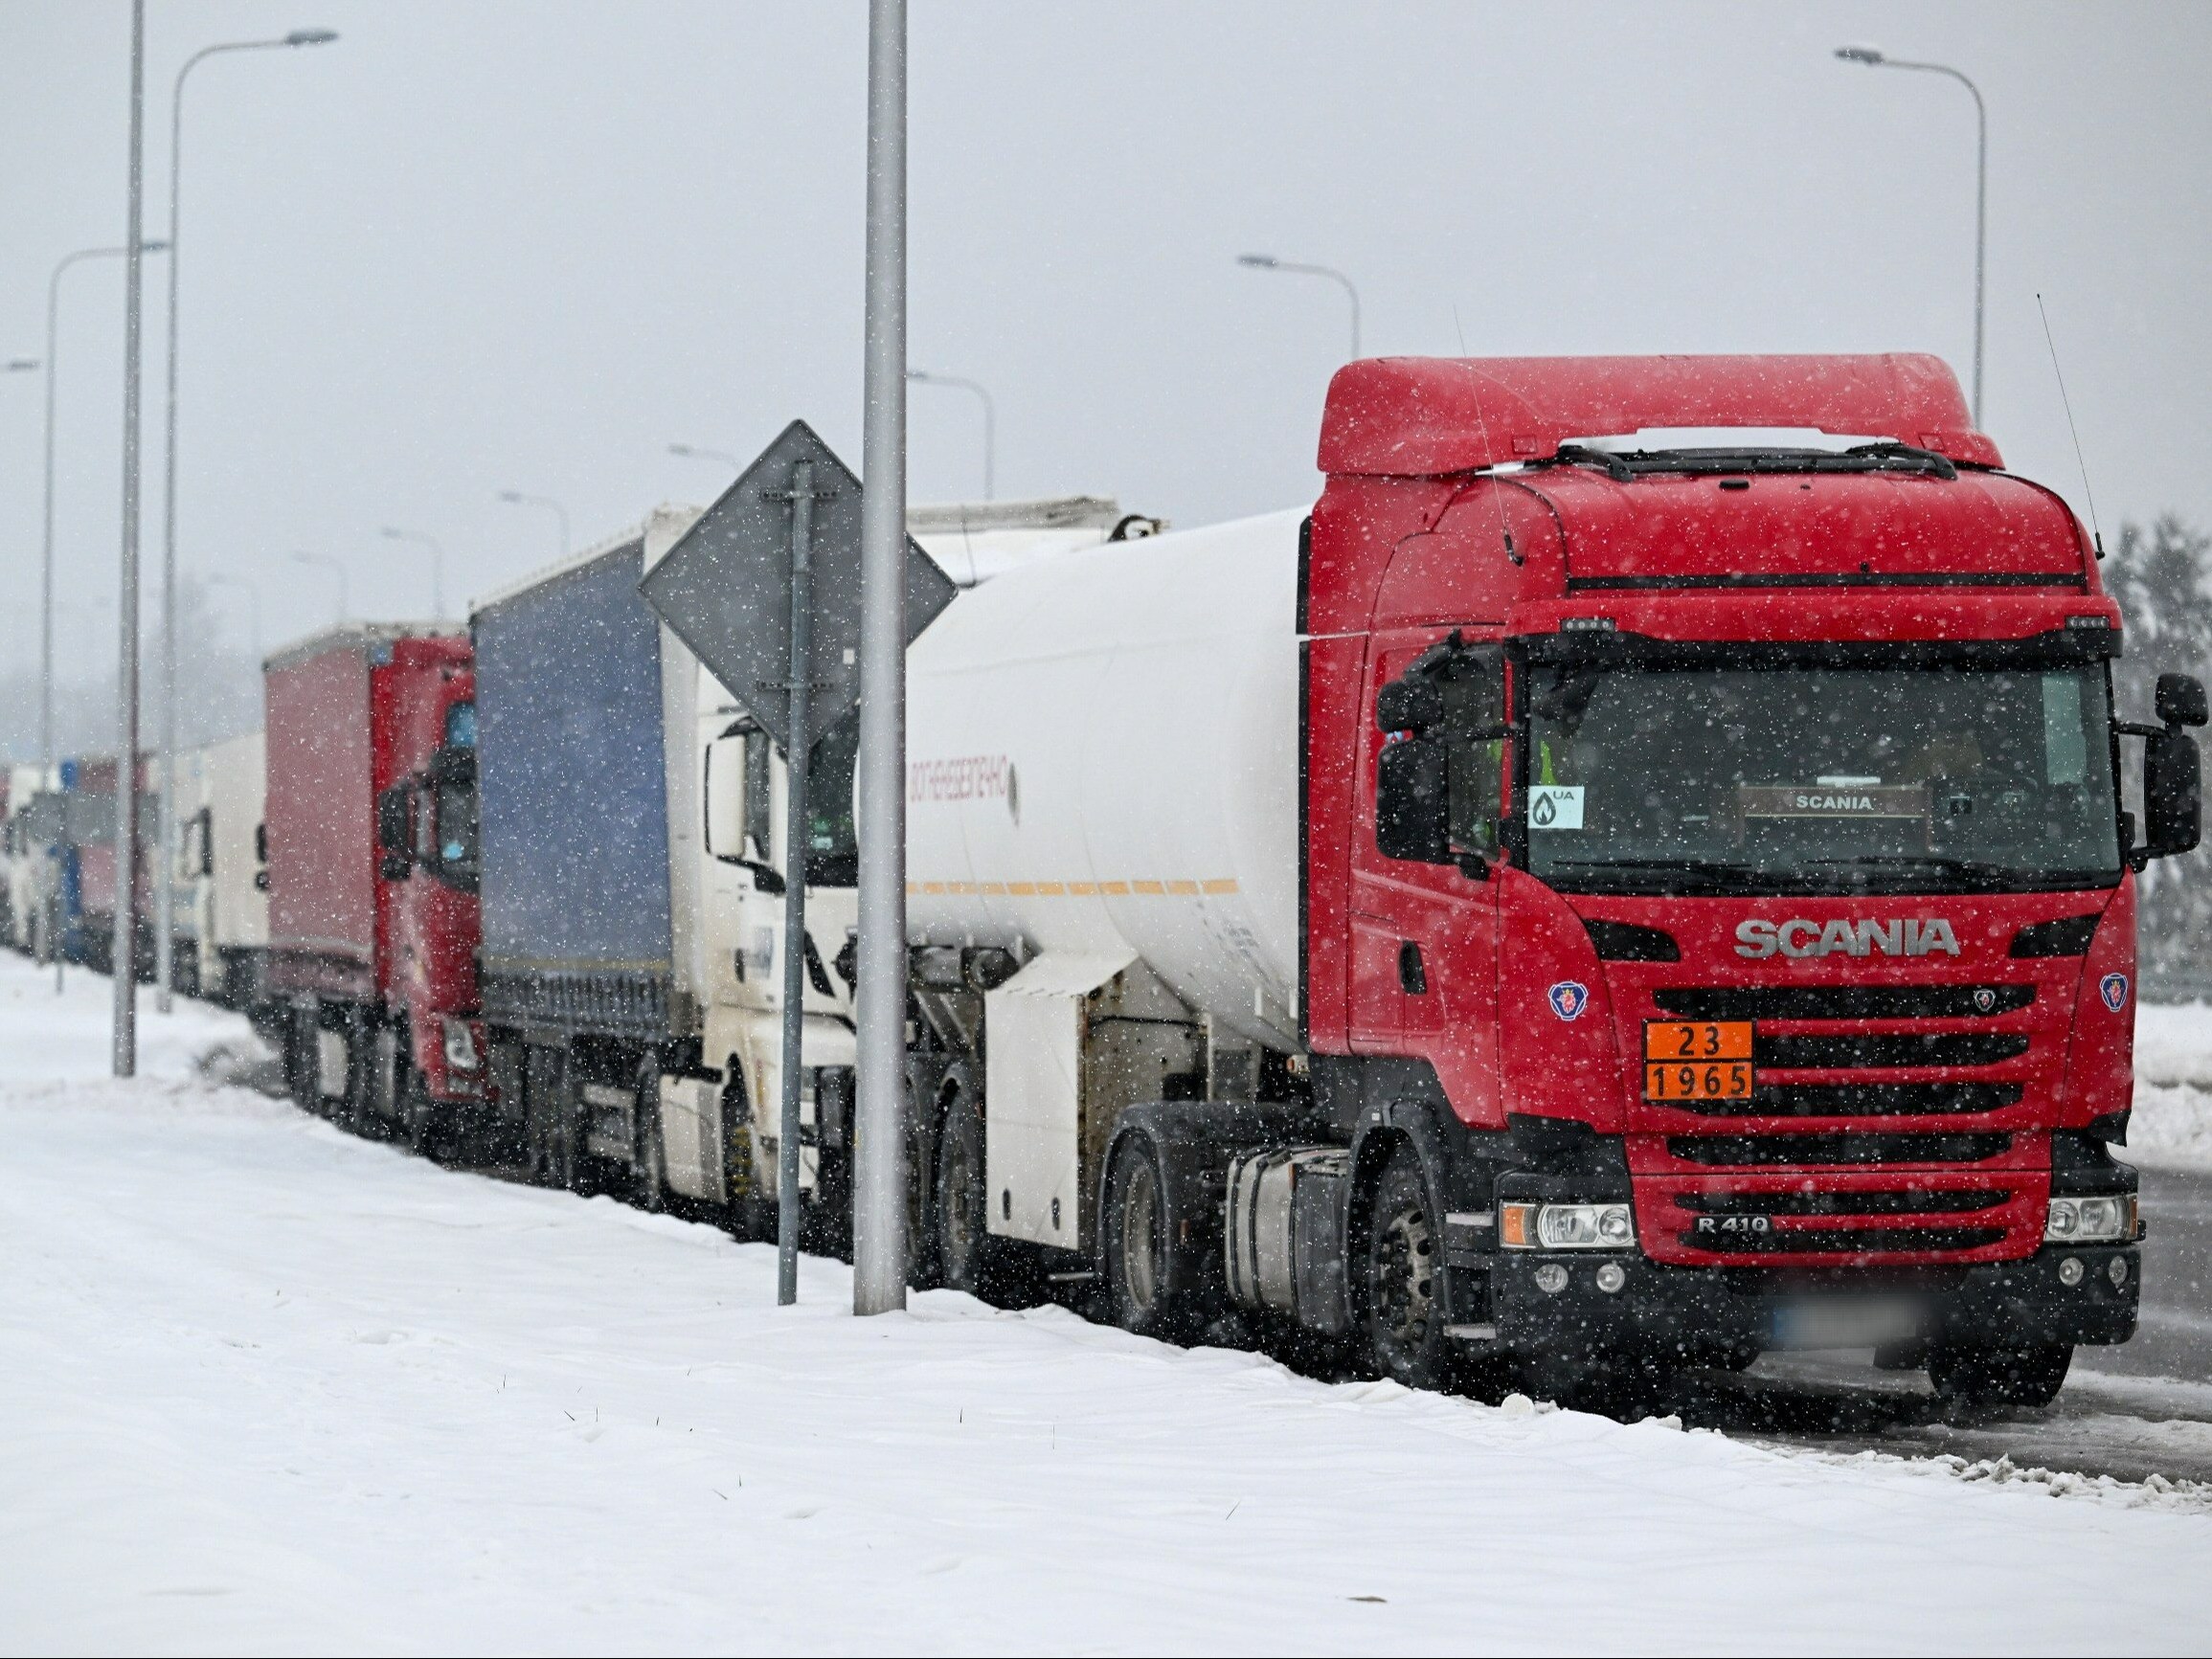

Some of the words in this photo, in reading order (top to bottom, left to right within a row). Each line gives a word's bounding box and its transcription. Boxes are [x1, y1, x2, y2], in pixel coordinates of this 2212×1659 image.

[1552, 790, 1574, 800] UA
[1795, 795, 1873, 810] SCANIA
[1733, 918, 1961, 958] SCANIA
[1678, 1025, 1721, 1056] 23
[1653, 1065, 1746, 1097] 1965
[1698, 1217, 1717, 1234] R
[1721, 1217, 1770, 1233] 410
